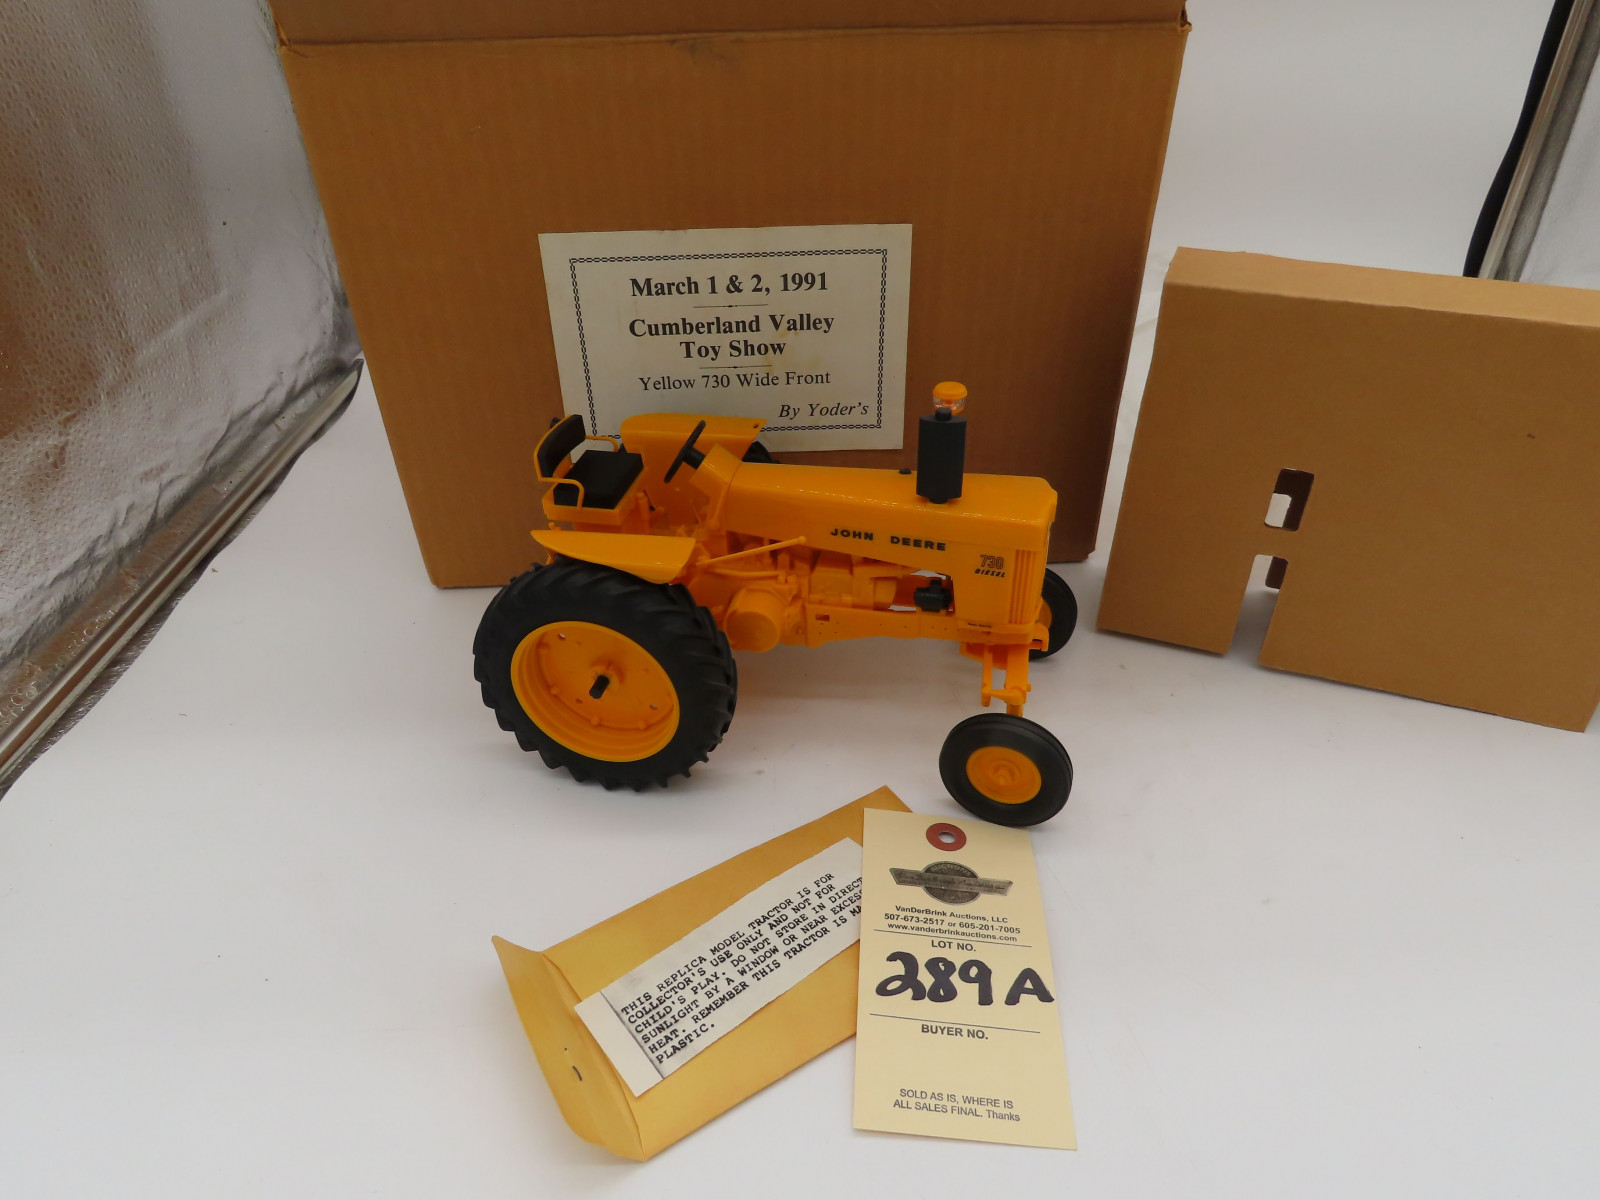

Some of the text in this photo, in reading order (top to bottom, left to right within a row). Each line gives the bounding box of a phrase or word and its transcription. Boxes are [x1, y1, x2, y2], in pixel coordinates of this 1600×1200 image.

[630, 272, 828, 296] March 1 & 2, 1991
[629, 313, 834, 337] Cumberland Valley
[680, 338, 786, 361] Toy Show
[639, 371, 830, 391] Yellow 730 Wide Front
[779, 402, 868, 420] By Yoder's
[830, 528, 946, 550] JOHN DEERE
[980, 554, 1004, 569] 730
[974, 568, 1005, 578] DIESEL
[884, 913, 944, 926] 507-673-2517
[959, 922, 1020, 934] 605-201-7005
[895, 905, 947, 918] VanDerBrink
[950, 912, 989, 922] Auctions,
[887, 922, 1018, 942] www.vanderbrinkauctions.com
[621, 874, 834, 1016] THIS REPLICA MODEL TRACTOR IS FOR
[628, 884, 836, 1024] COLLECTOR'S USE ONLY AND NOT FOR
[932, 940, 976, 952] LOT NO.
[634, 995, 686, 1034] CHILD'S
[692, 971, 726, 996] PLAY.
[731, 955, 746, 968] DO
[750, 937, 772, 954] NOT
[776, 914, 809, 938] STORE
[812, 902, 826, 914] IN
[876, 951, 1054, 1006] 289 A
[641, 998, 700, 1044] SUNLIGHT
[704, 986, 720, 999] BY
[726, 977, 735, 986] A
[738, 947, 780, 977] WINDOW
[782, 933, 798, 946] OR
[800, 915, 828, 934] NEAR
[648, 1029, 686, 1054] HEAT.
[691, 981, 750, 1024] REMEMBER
[752, 960, 781, 982] THIS
[784, 927, 830, 960] TRACTOR
[832, 915, 848, 928] IS
[656, 1022, 716, 1064] PLASTIC.
[921, 1024, 988, 1040] BUYER NO.
[900, 1089, 1014, 1109] SOLD AS IS, WHERE IS
[893, 1099, 1020, 1122] ALL SALES FINAL. Thanks
